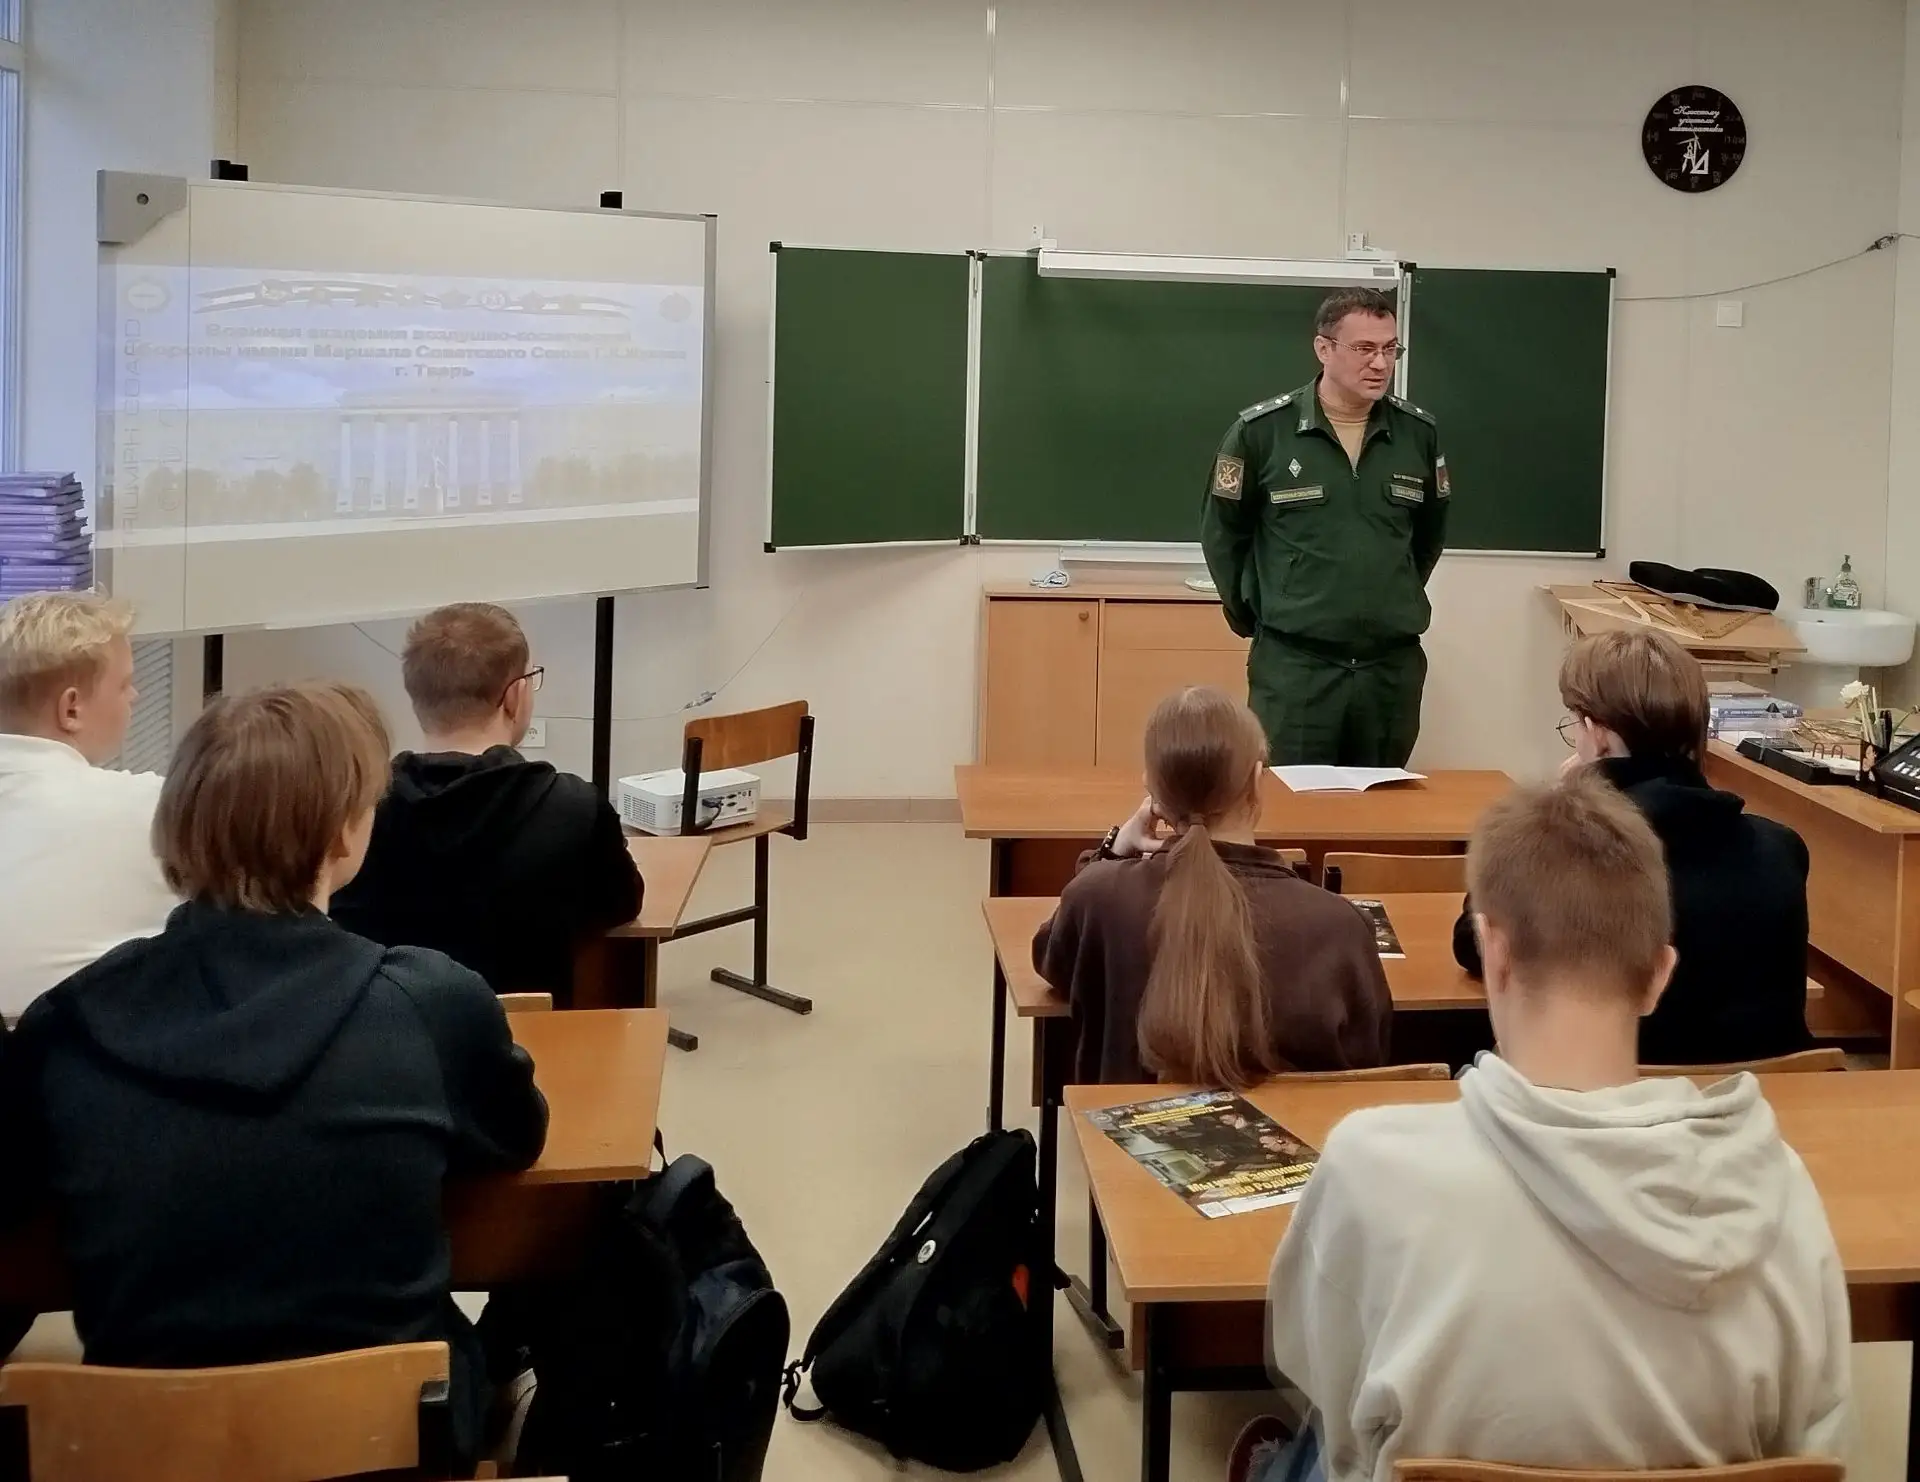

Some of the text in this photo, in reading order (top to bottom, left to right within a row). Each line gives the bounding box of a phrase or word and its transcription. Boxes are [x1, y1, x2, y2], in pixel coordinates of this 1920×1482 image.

[205, 323, 304, 338] Военная
[412, 329, 632, 344] воздушно-косми
[313, 344, 411, 361] Маршала
[394, 364, 475, 379] г. Тверь
